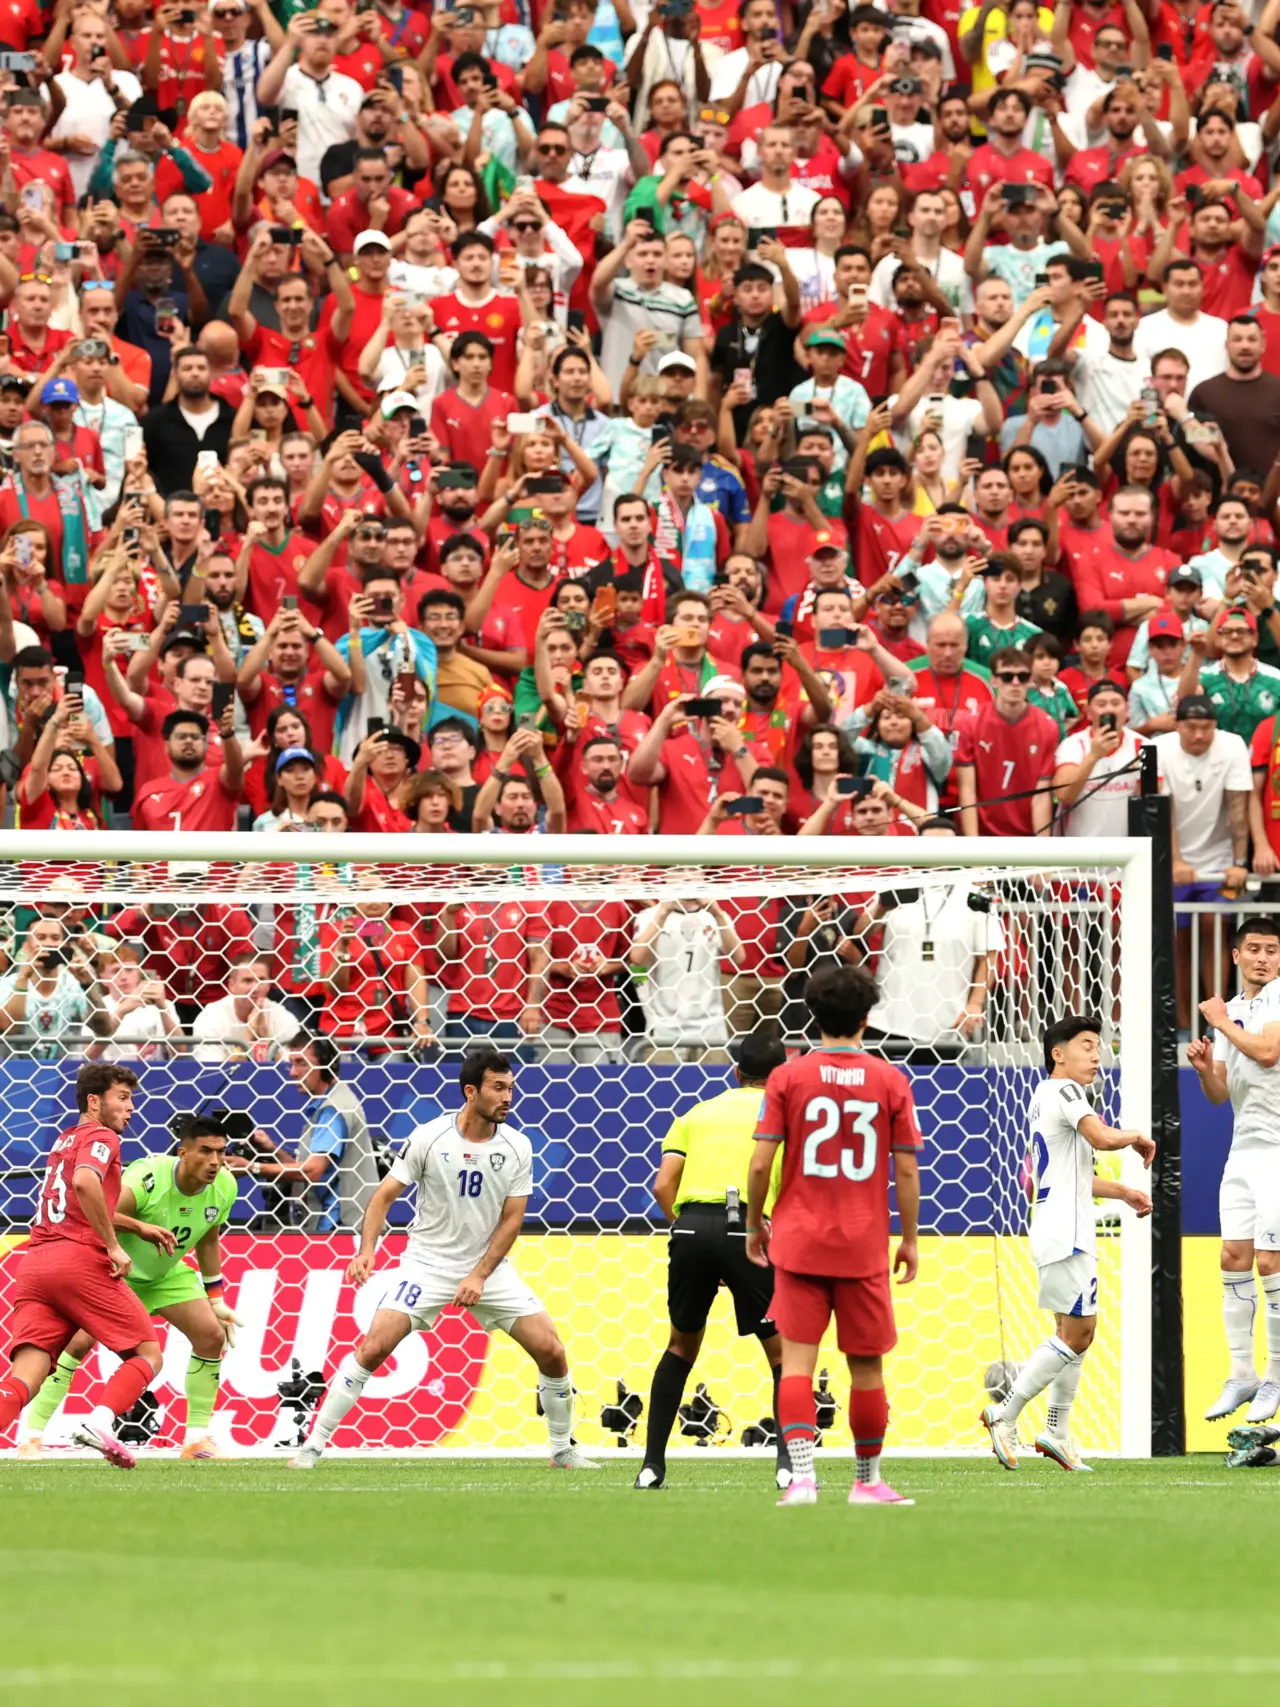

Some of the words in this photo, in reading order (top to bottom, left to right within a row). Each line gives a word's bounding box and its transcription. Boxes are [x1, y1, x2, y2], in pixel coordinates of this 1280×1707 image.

[861, 349, 874, 379] 7
[1003, 760, 1016, 791] 7
[685, 951, 694, 973] 7
[803, 1095, 879, 1182] 23
[457, 1169, 484, 1198] 18
[394, 1280, 423, 1308] 18
